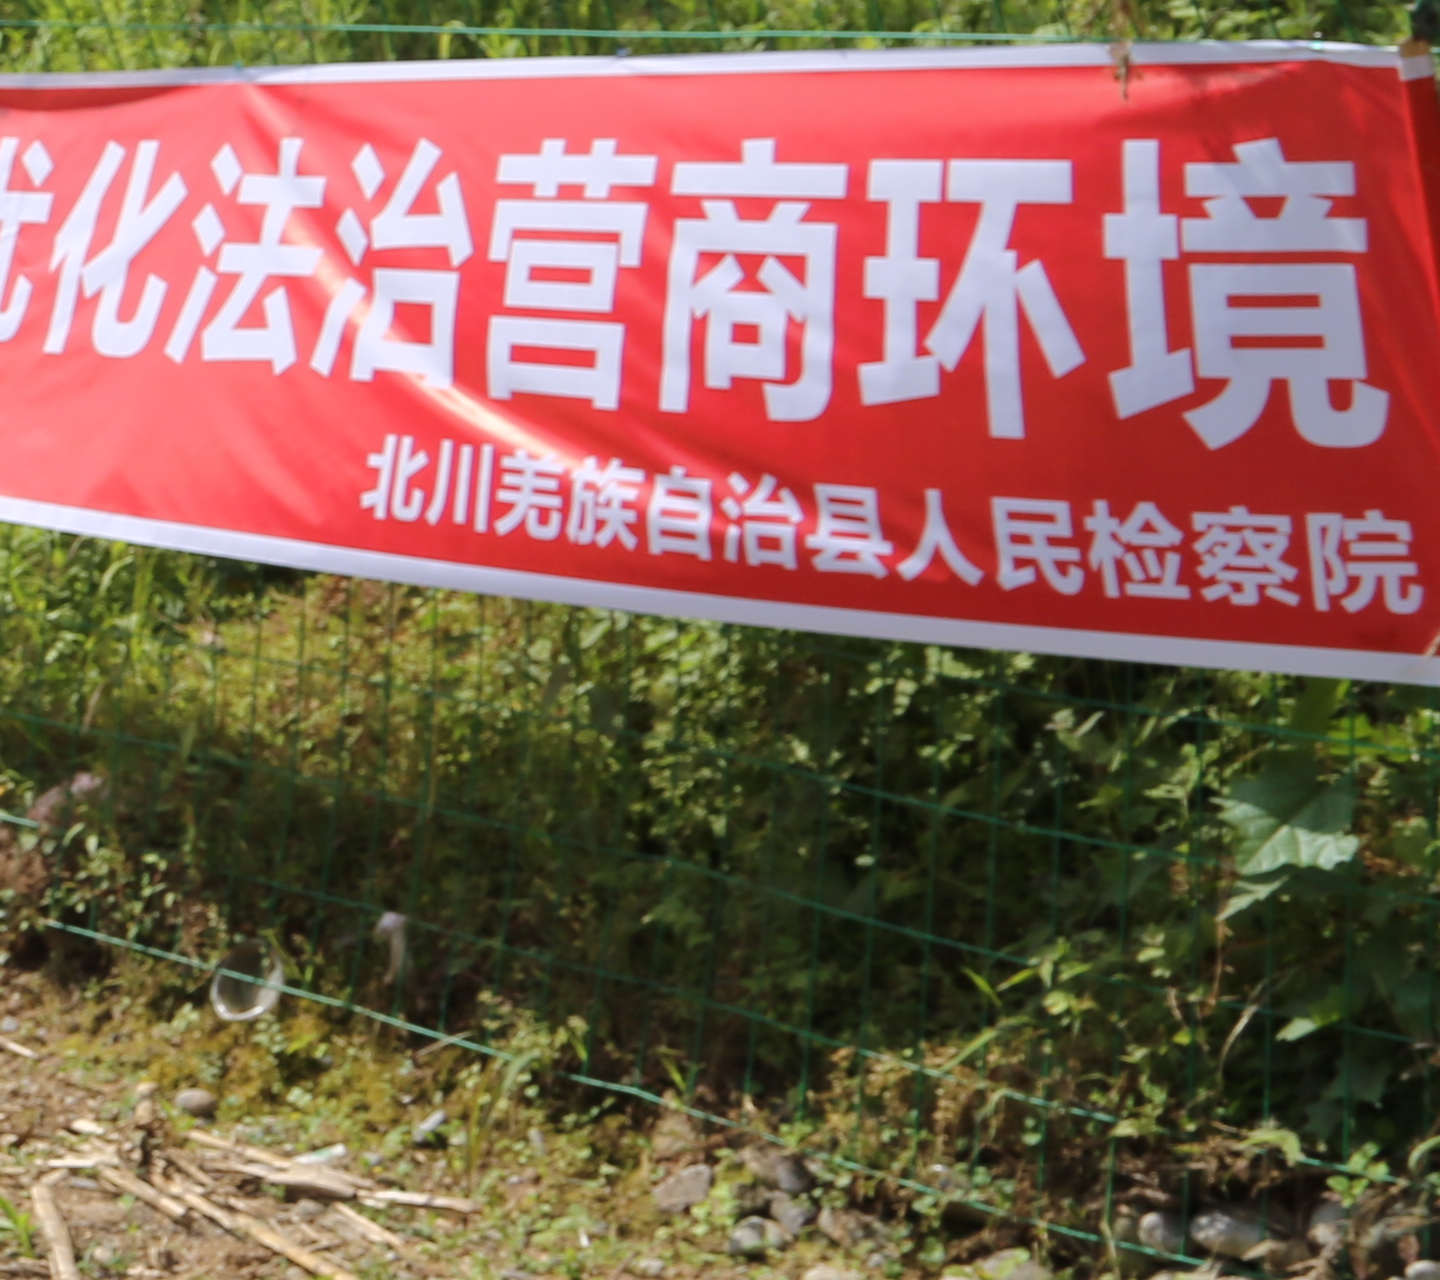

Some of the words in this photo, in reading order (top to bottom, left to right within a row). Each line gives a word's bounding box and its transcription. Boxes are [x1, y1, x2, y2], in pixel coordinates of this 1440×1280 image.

[360, 433, 1424, 616] 北川羌族自治县人民检察院
